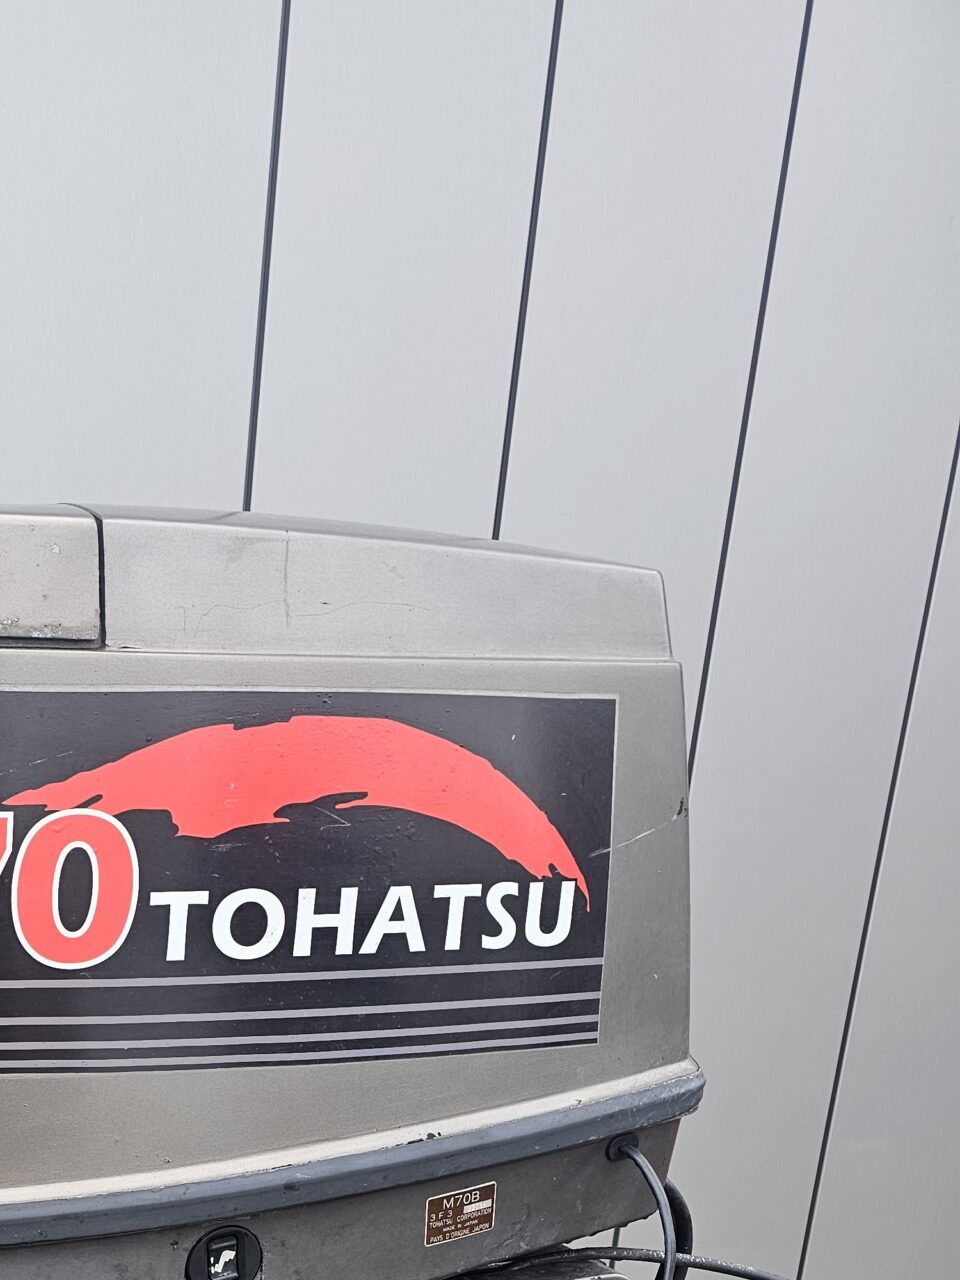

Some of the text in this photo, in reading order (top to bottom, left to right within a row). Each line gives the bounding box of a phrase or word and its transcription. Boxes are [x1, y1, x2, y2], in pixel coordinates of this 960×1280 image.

[150, 880, 576, 962] TOHATSU
[443, 1191, 480, 1209] M70B
[429, 1208, 492, 1228] TOHATSU CORPORATION
[430, 1235, 443, 1243] PAYS
